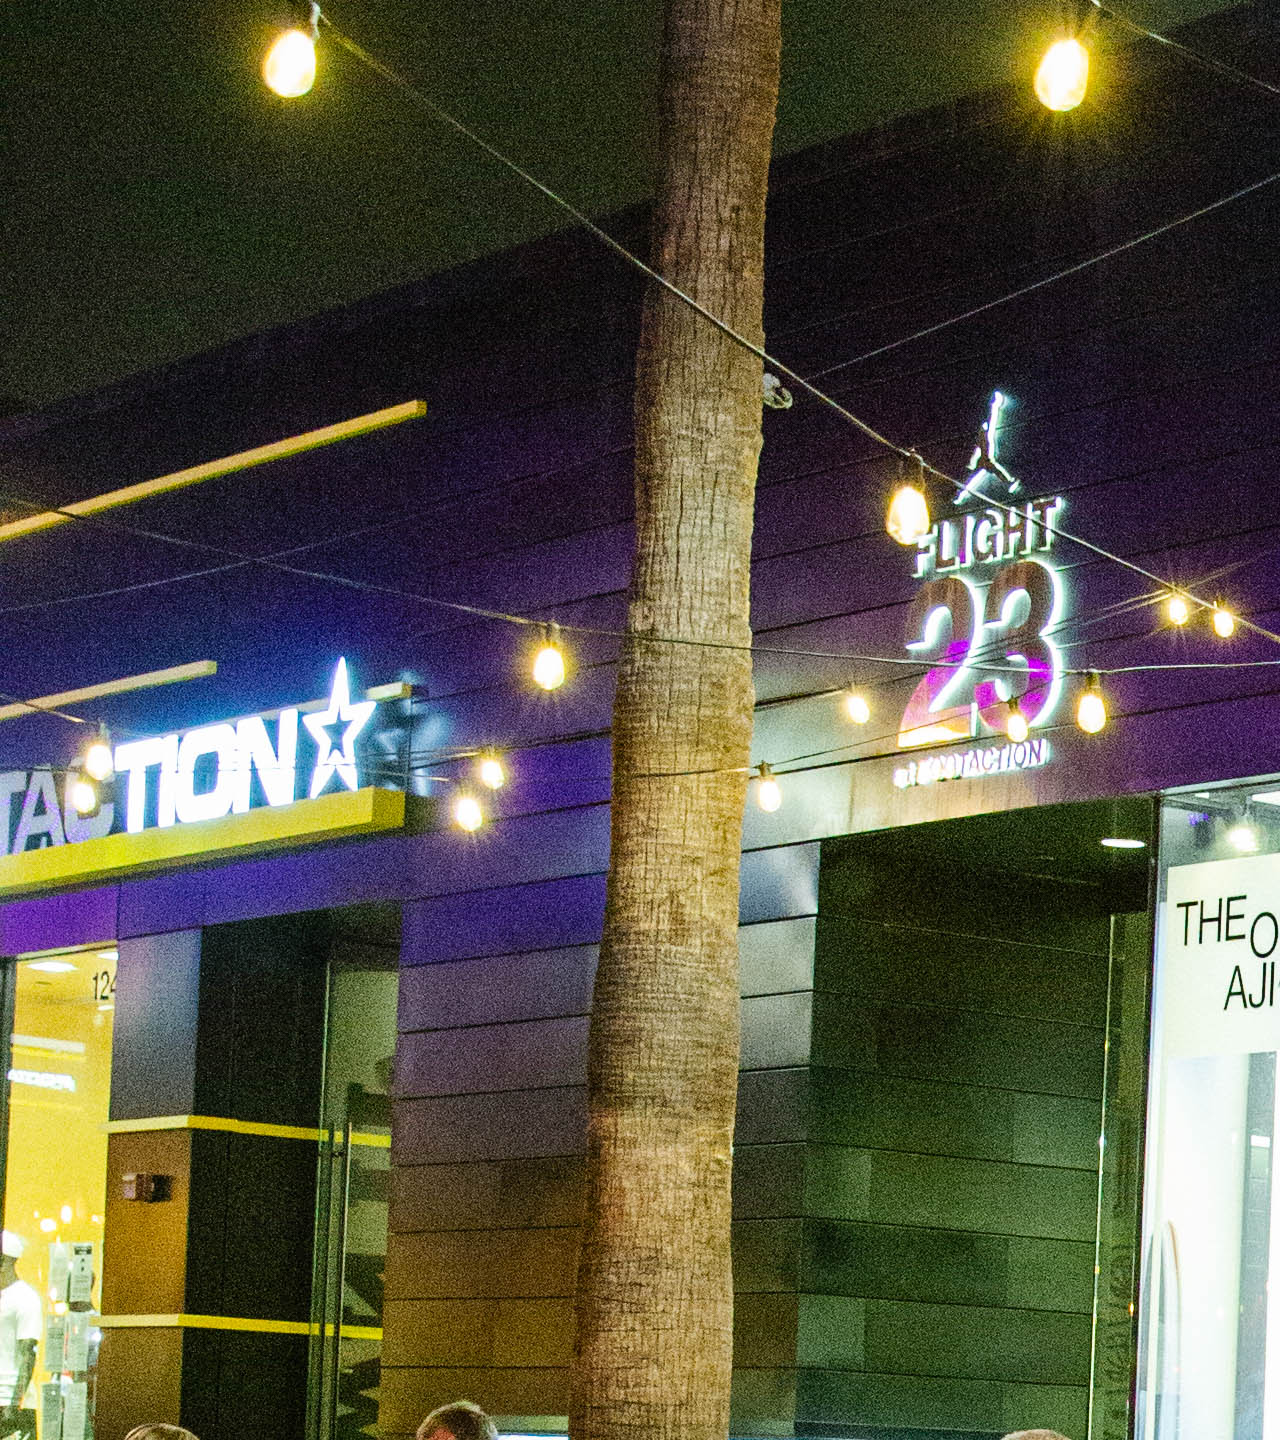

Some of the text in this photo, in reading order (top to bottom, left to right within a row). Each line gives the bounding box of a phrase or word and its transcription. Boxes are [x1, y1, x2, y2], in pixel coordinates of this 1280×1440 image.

[913, 497, 1065, 578] FLIGHT
[898, 559, 1063, 748] 23
[1176, 895, 1248, 947] THE
